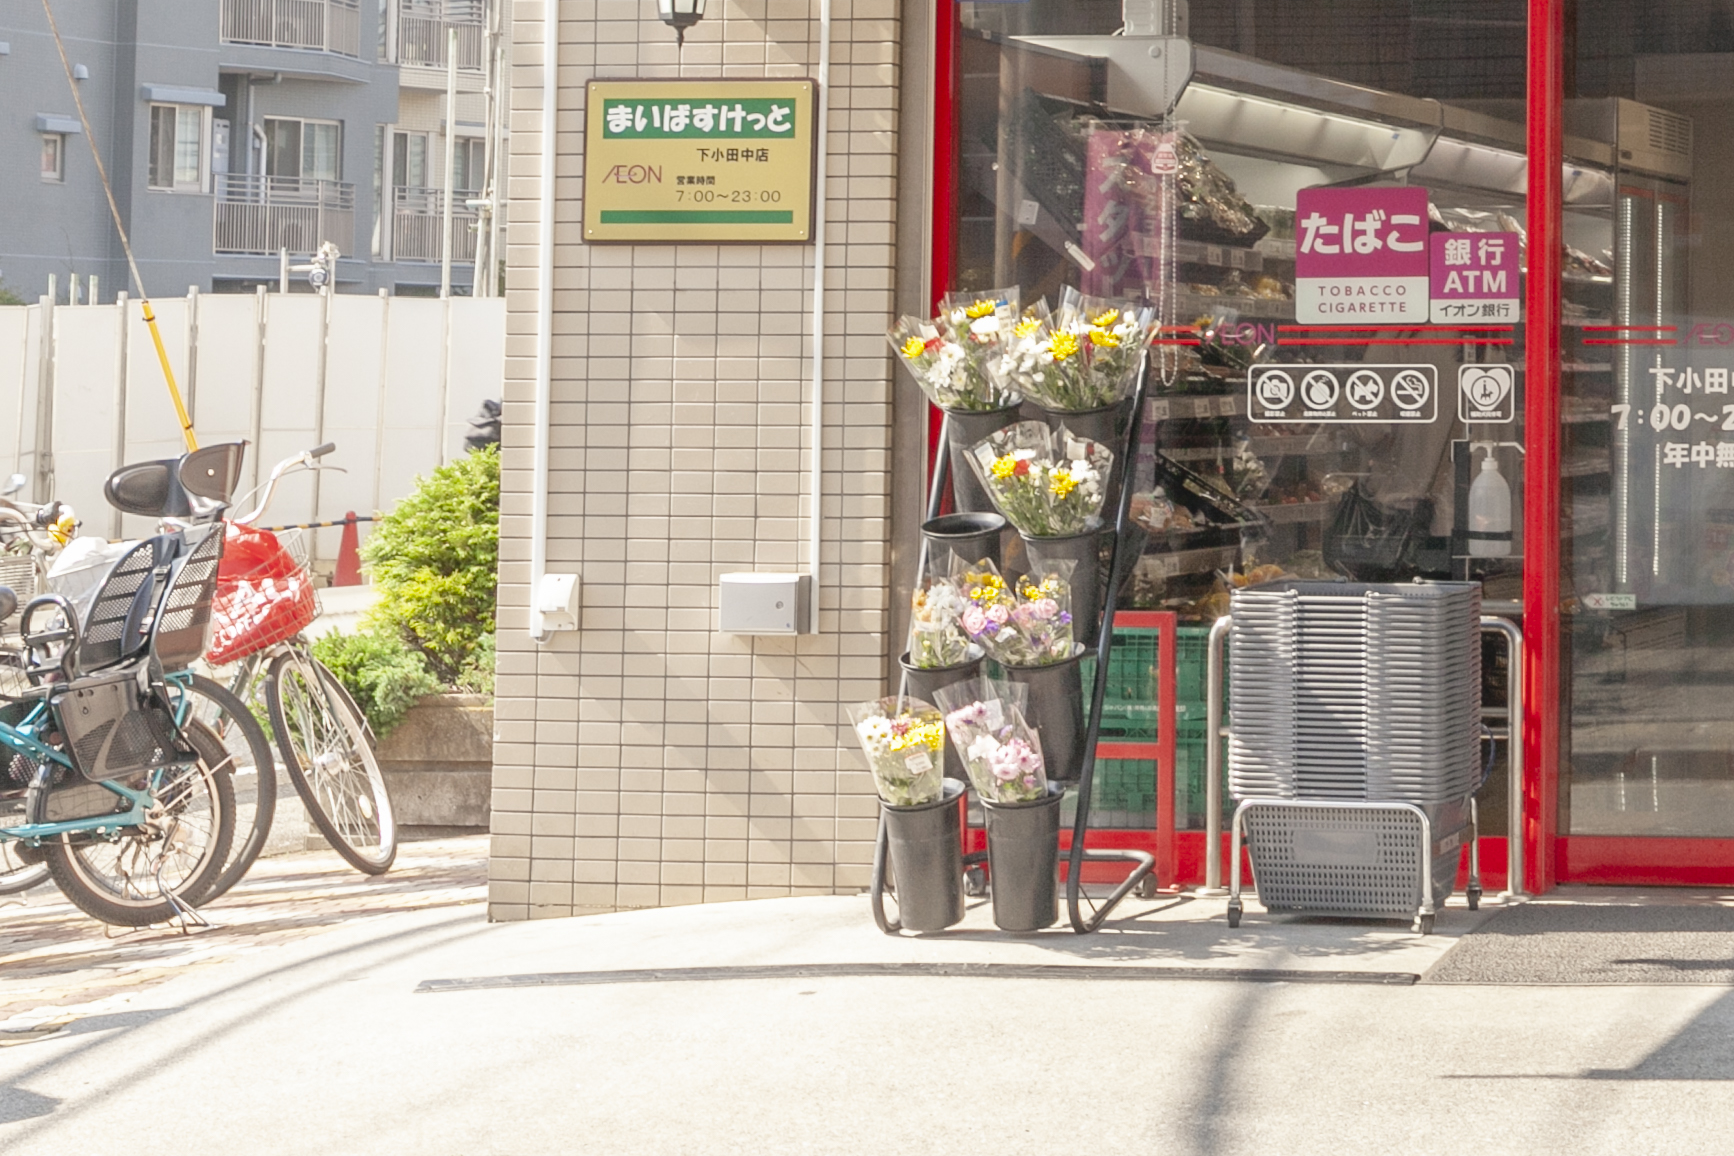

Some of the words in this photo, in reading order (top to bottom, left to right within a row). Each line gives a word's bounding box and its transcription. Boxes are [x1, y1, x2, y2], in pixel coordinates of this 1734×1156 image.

[606, 103, 792, 134] まいばすけっと
[696, 147, 769, 163] 下小田中店
[676, 175, 715, 186] 営業時間
[1300, 209, 1424, 255] たばこ
[1444, 238, 1505, 266] 銀行
[1443, 270, 1507, 293] ATM
[1318, 285, 1407, 297] TOBACCO
[1318, 301, 1407, 314] CIGARETTE
[1439, 303, 1510, 317] イオン銀行
